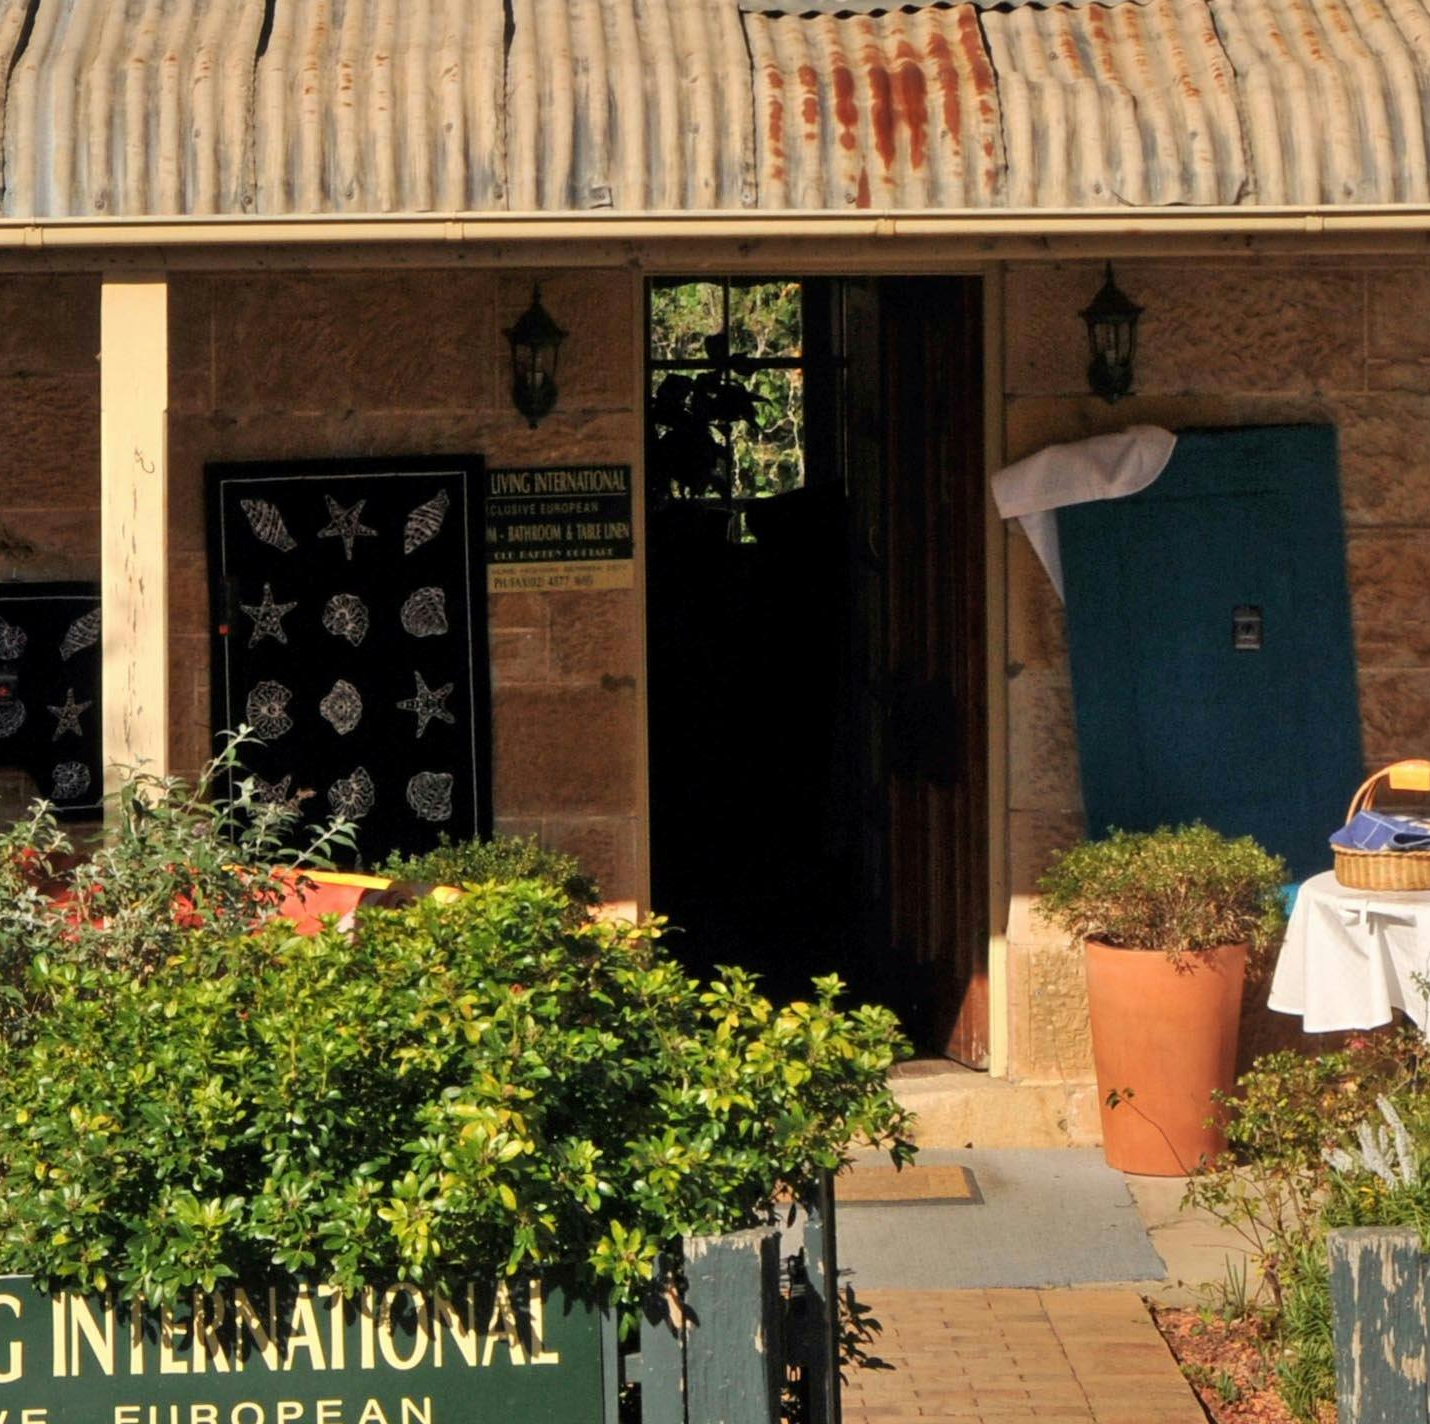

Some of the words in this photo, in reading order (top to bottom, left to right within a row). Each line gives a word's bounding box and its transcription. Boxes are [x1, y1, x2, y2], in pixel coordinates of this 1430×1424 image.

[490, 471, 531, 495] LIVING
[534, 469, 627, 493] INTERNATIONAL
[486, 503, 536, 517] CLUSIVE
[540, 501, 599, 515] EUROPEAN
[507, 523, 561, 543] BATHROOM
[576, 521, 601, 540] TABLE
[604, 521, 630, 539] LINEN
[52, 1278, 560, 1377] INTERNATIONAL
[114, 1396, 432, 1424] EUROPEAN
